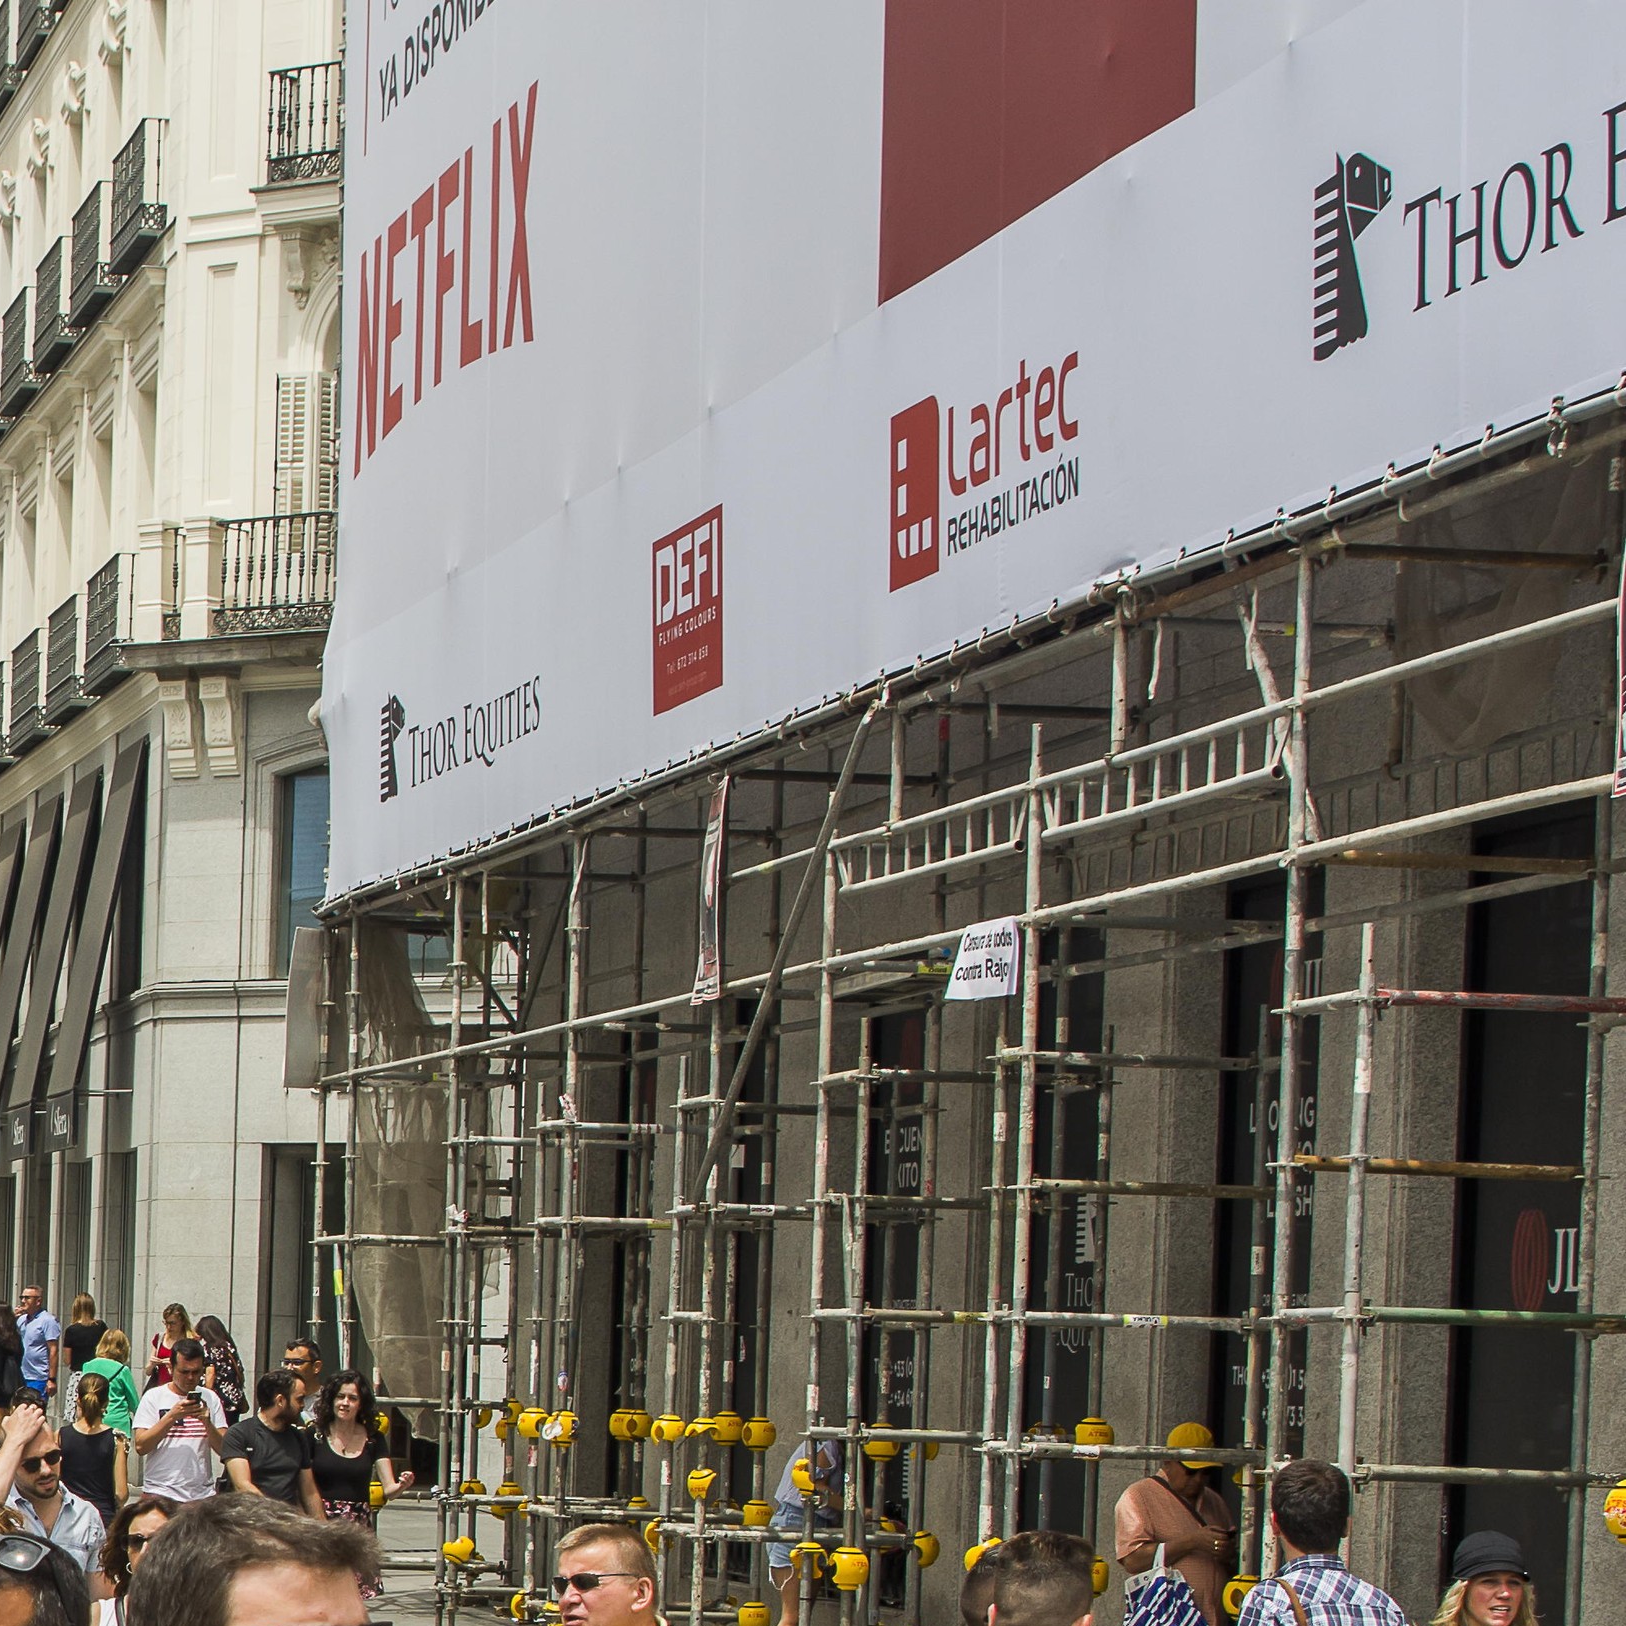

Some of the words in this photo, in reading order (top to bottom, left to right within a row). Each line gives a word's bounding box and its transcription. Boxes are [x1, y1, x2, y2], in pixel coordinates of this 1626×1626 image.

[379, 53, 398, 122] YA
[403, 0, 499, 98] DISPONI
[353, 79, 539, 480] NETFLIX
[1403, 142, 1584, 313] THOR
[948, 350, 1080, 496] Lartec
[655, 506, 723, 628] DEFI
[947, 455, 1081, 558] REHABILITACIÓN
[657, 622, 683, 647] FLYING
[683, 605, 717, 638] COLOURS
[408, 719, 459, 788] THOR
[464, 675, 541, 768] EQUITIES
[955, 961, 983, 981] contra
[985, 957, 1008, 983] Rajo
